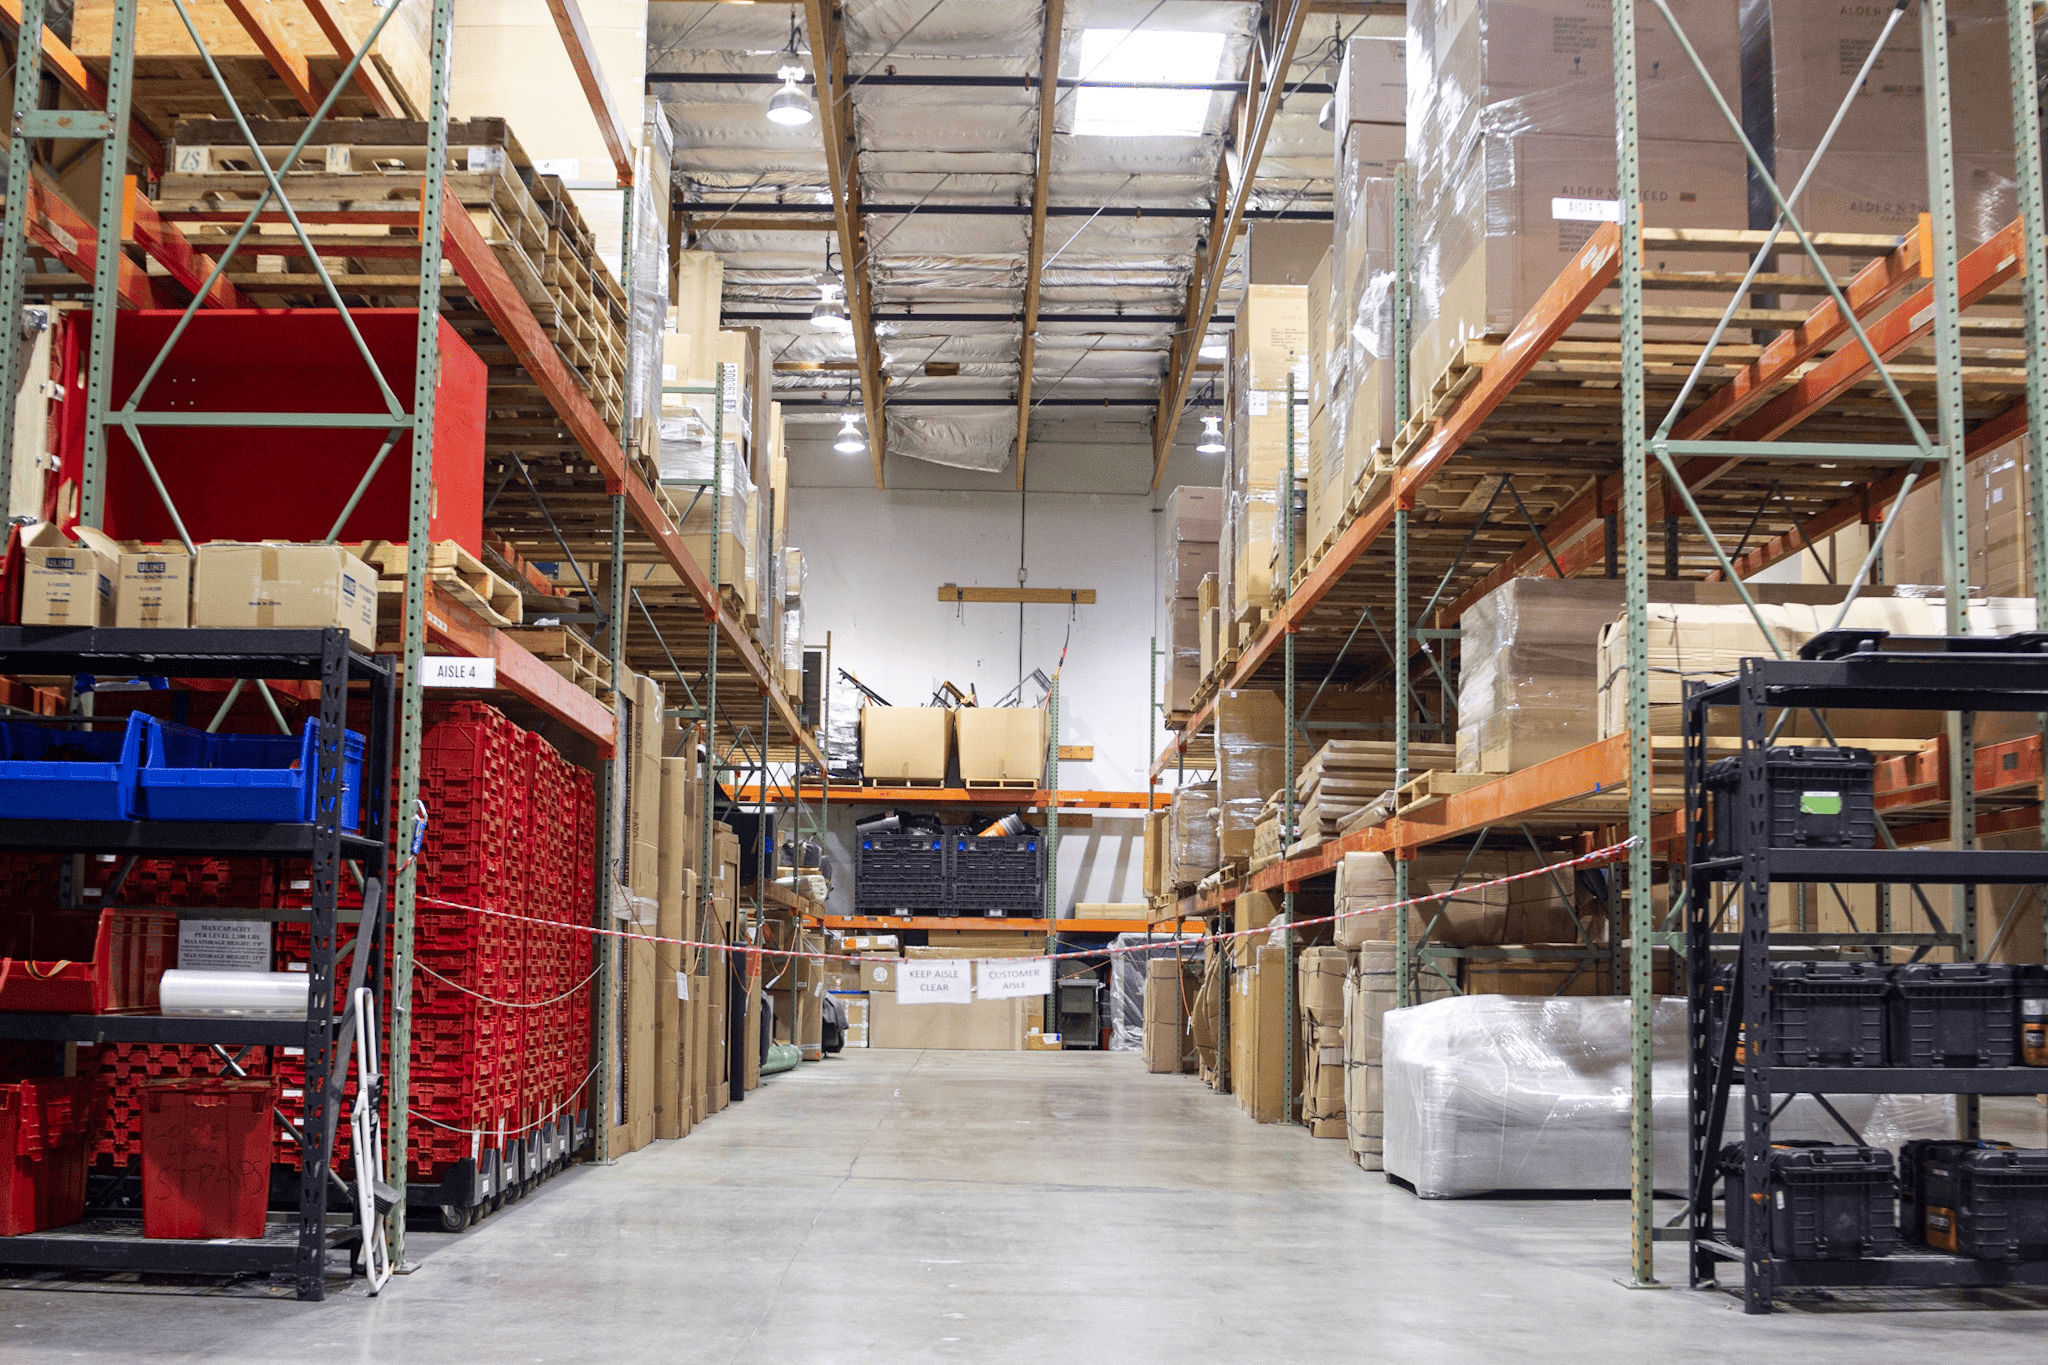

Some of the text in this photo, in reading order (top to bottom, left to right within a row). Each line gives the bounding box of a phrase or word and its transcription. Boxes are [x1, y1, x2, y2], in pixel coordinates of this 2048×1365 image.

[138, 562, 165, 573] ULINE
[437, 665, 476, 678] AISLE 4
[909, 970, 959, 978] KEEP AISLE
[988, 969, 1040, 980] CUSTOMER
[920, 983, 950, 992] CLEAR
[1003, 981, 1026, 990] AISLE
